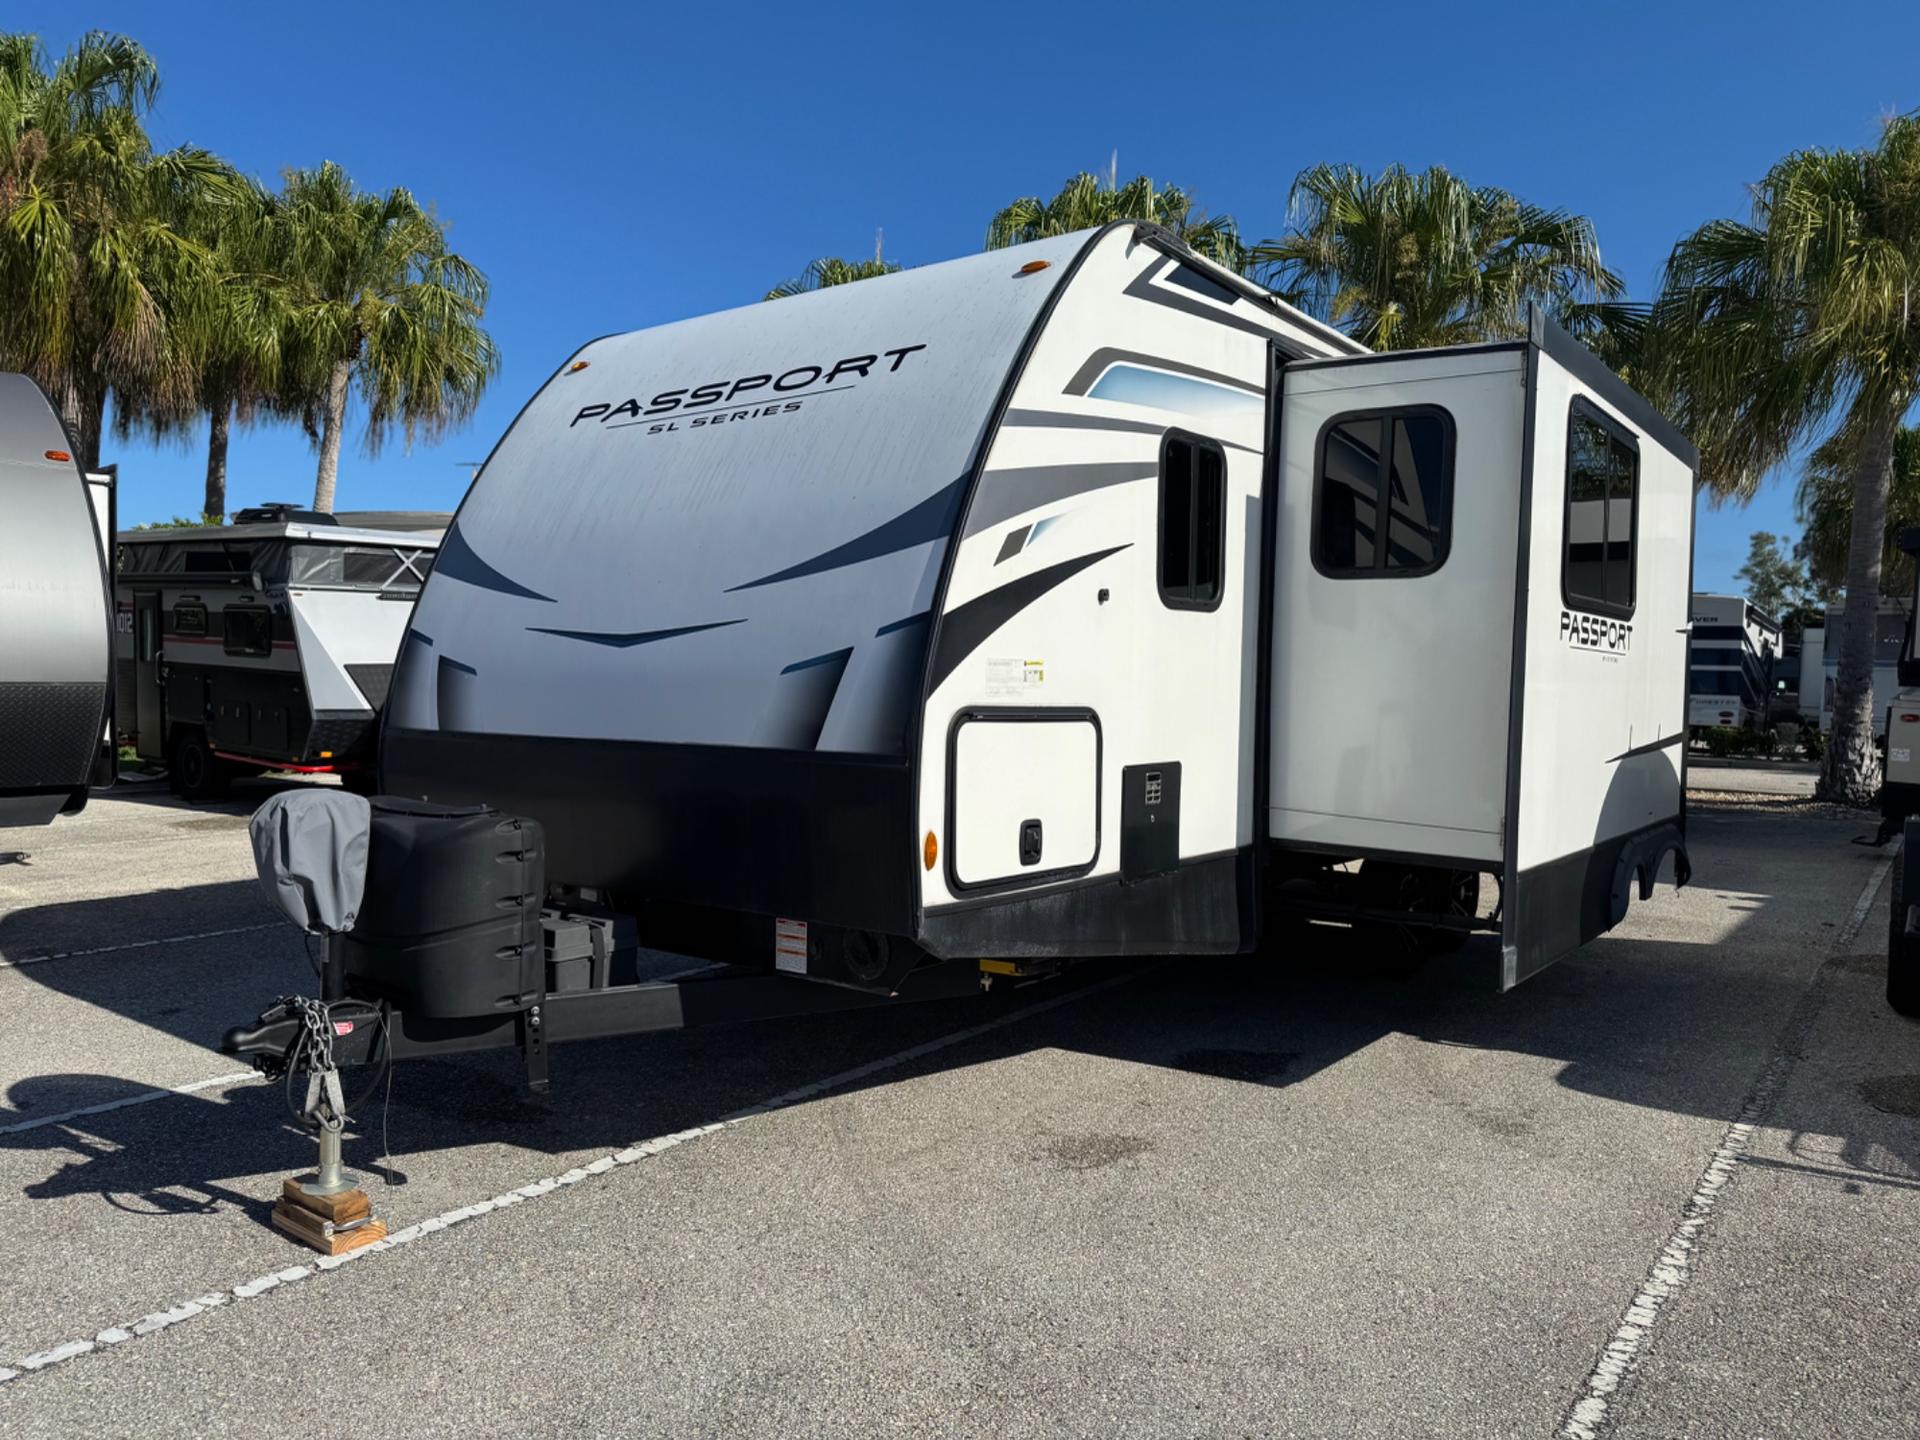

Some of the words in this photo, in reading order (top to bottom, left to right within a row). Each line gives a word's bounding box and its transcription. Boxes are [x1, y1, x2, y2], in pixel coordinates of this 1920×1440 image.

[570, 343, 928, 428] PASSPORT
[647, 422, 680, 436] SL
[689, 401, 803, 429] SERIES
[1559, 610, 1633, 652] PASSPORT
